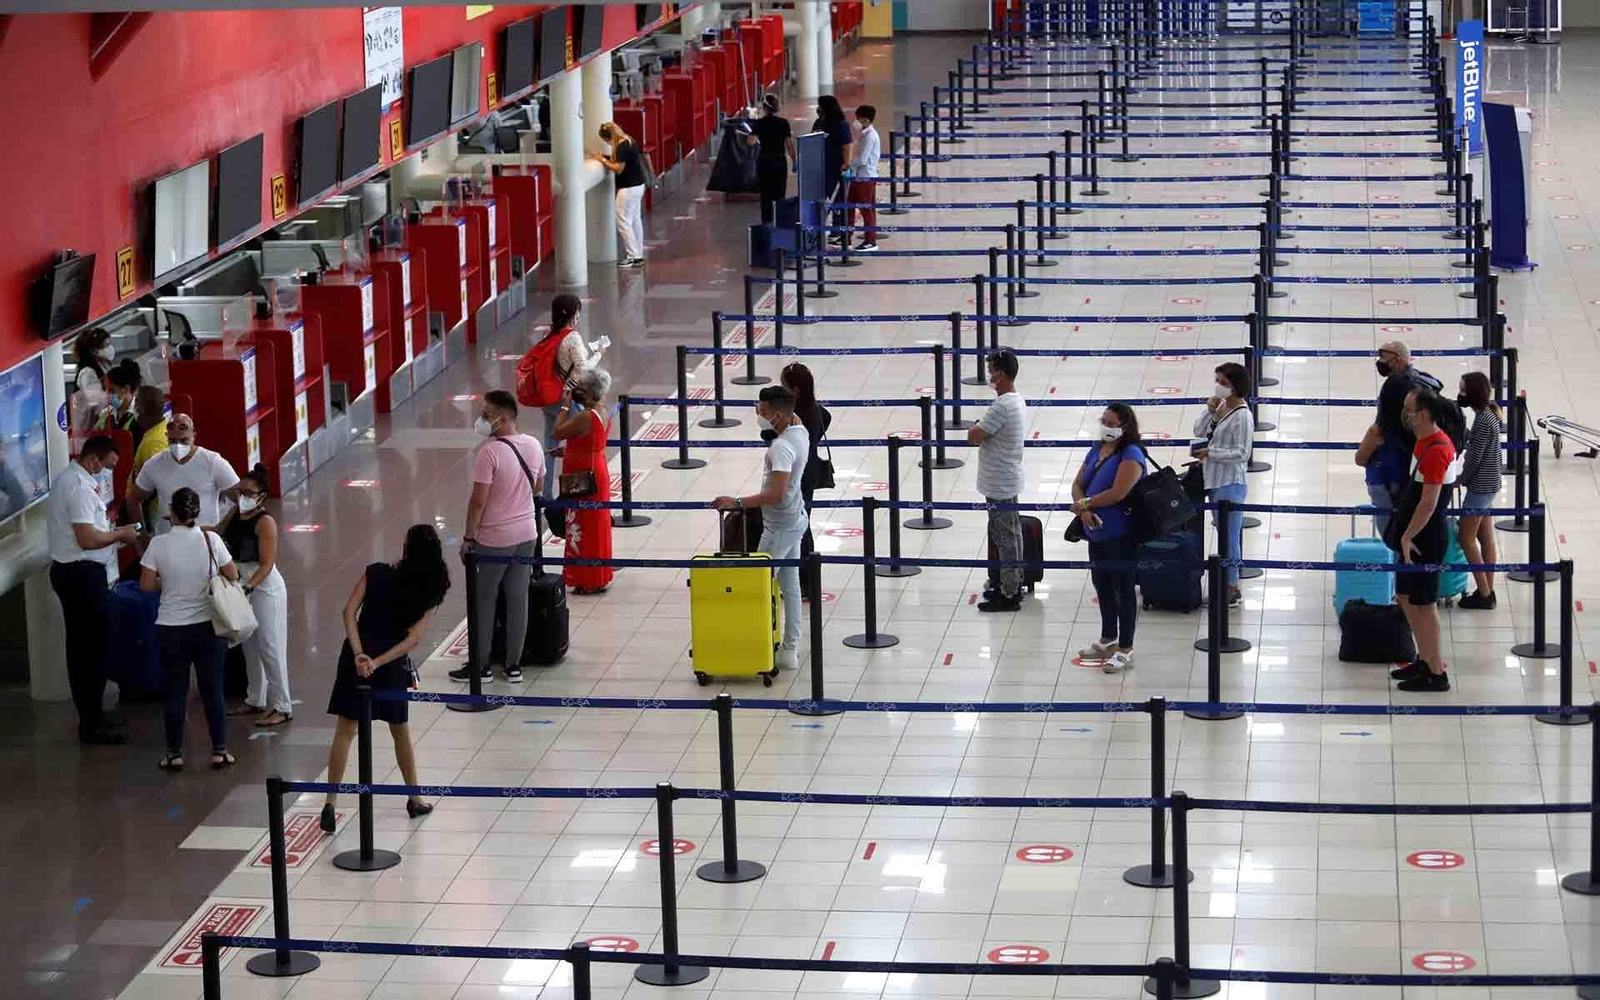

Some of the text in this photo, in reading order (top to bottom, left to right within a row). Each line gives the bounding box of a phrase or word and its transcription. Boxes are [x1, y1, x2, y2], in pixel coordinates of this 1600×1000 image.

[1460, 41, 1480, 121] jetBlue
[274, 183, 284, 208] 29
[120, 258, 132, 288] 27
